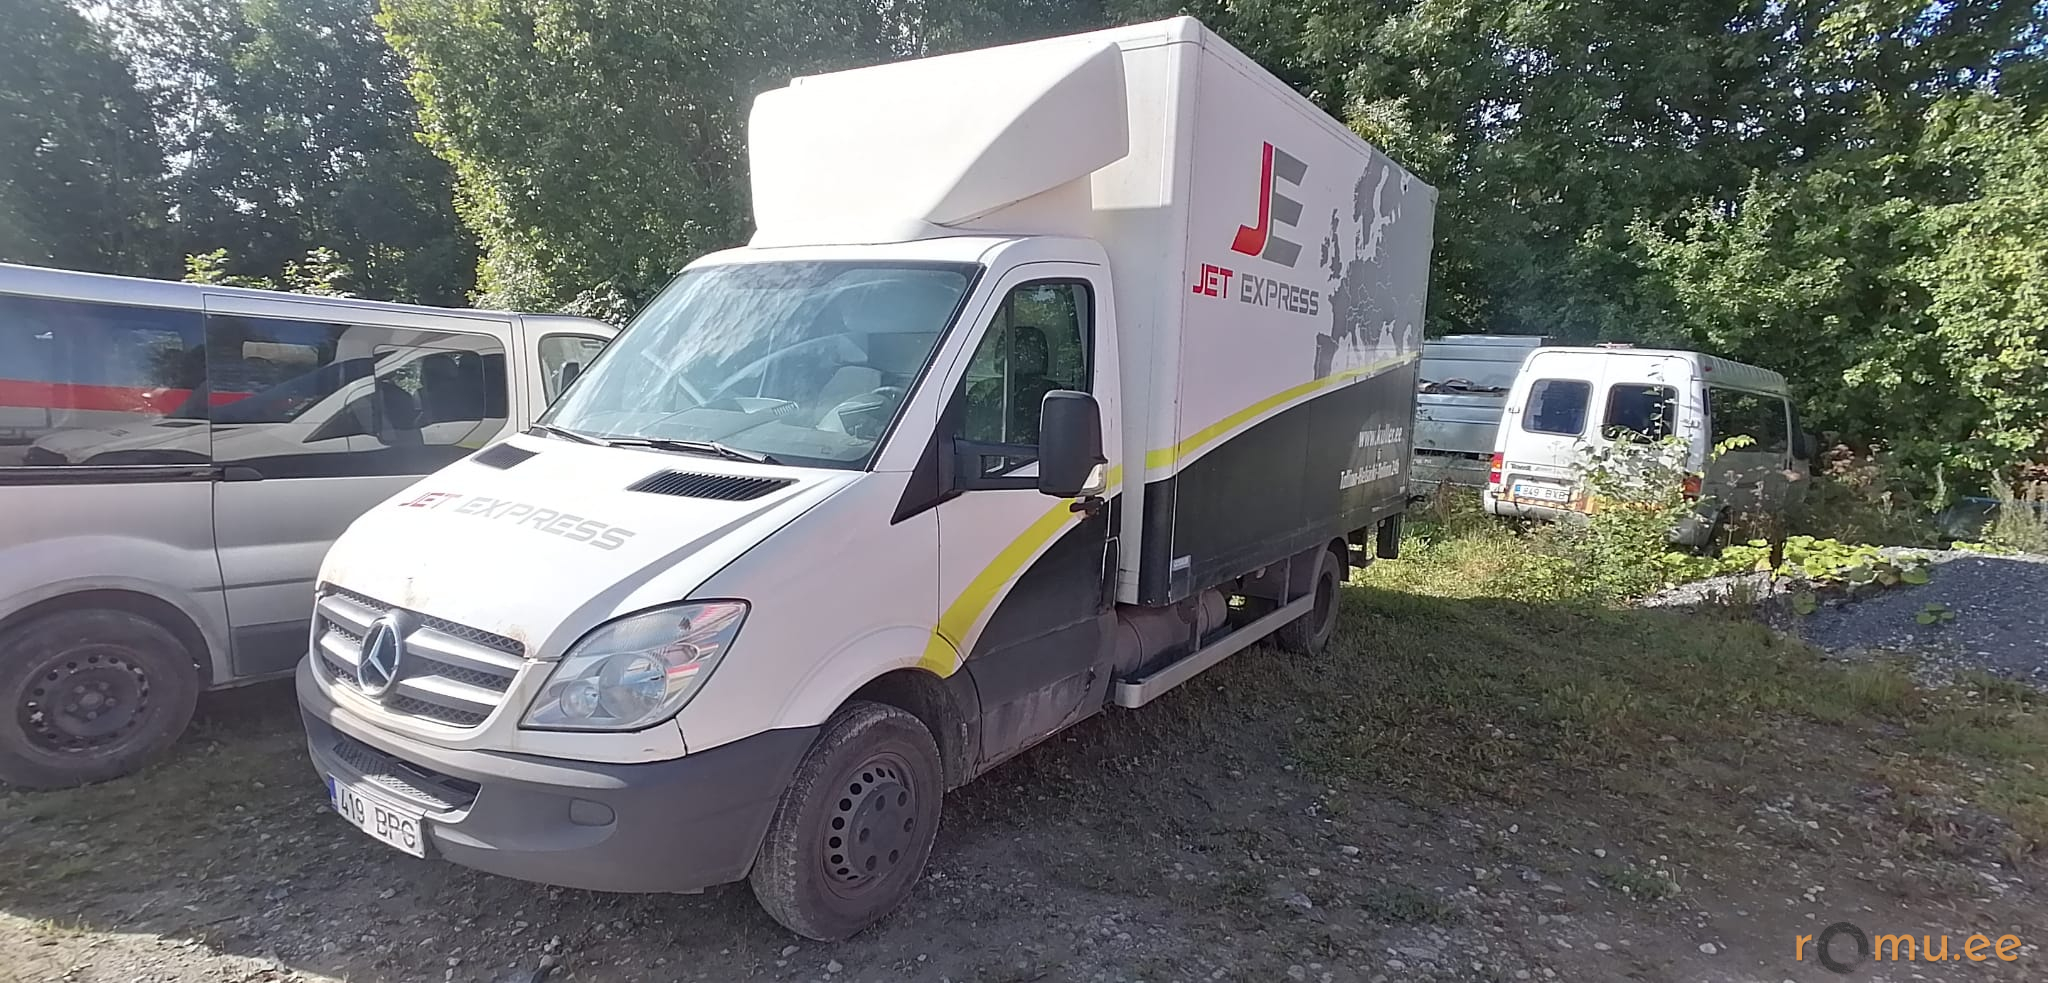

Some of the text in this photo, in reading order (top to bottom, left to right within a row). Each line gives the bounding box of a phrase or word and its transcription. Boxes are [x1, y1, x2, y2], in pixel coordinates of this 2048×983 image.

[1192, 263, 1319, 315] JET EXPRESS
[398, 492, 636, 551] JET EXPRESS
[341, 789, 365, 825] 419
